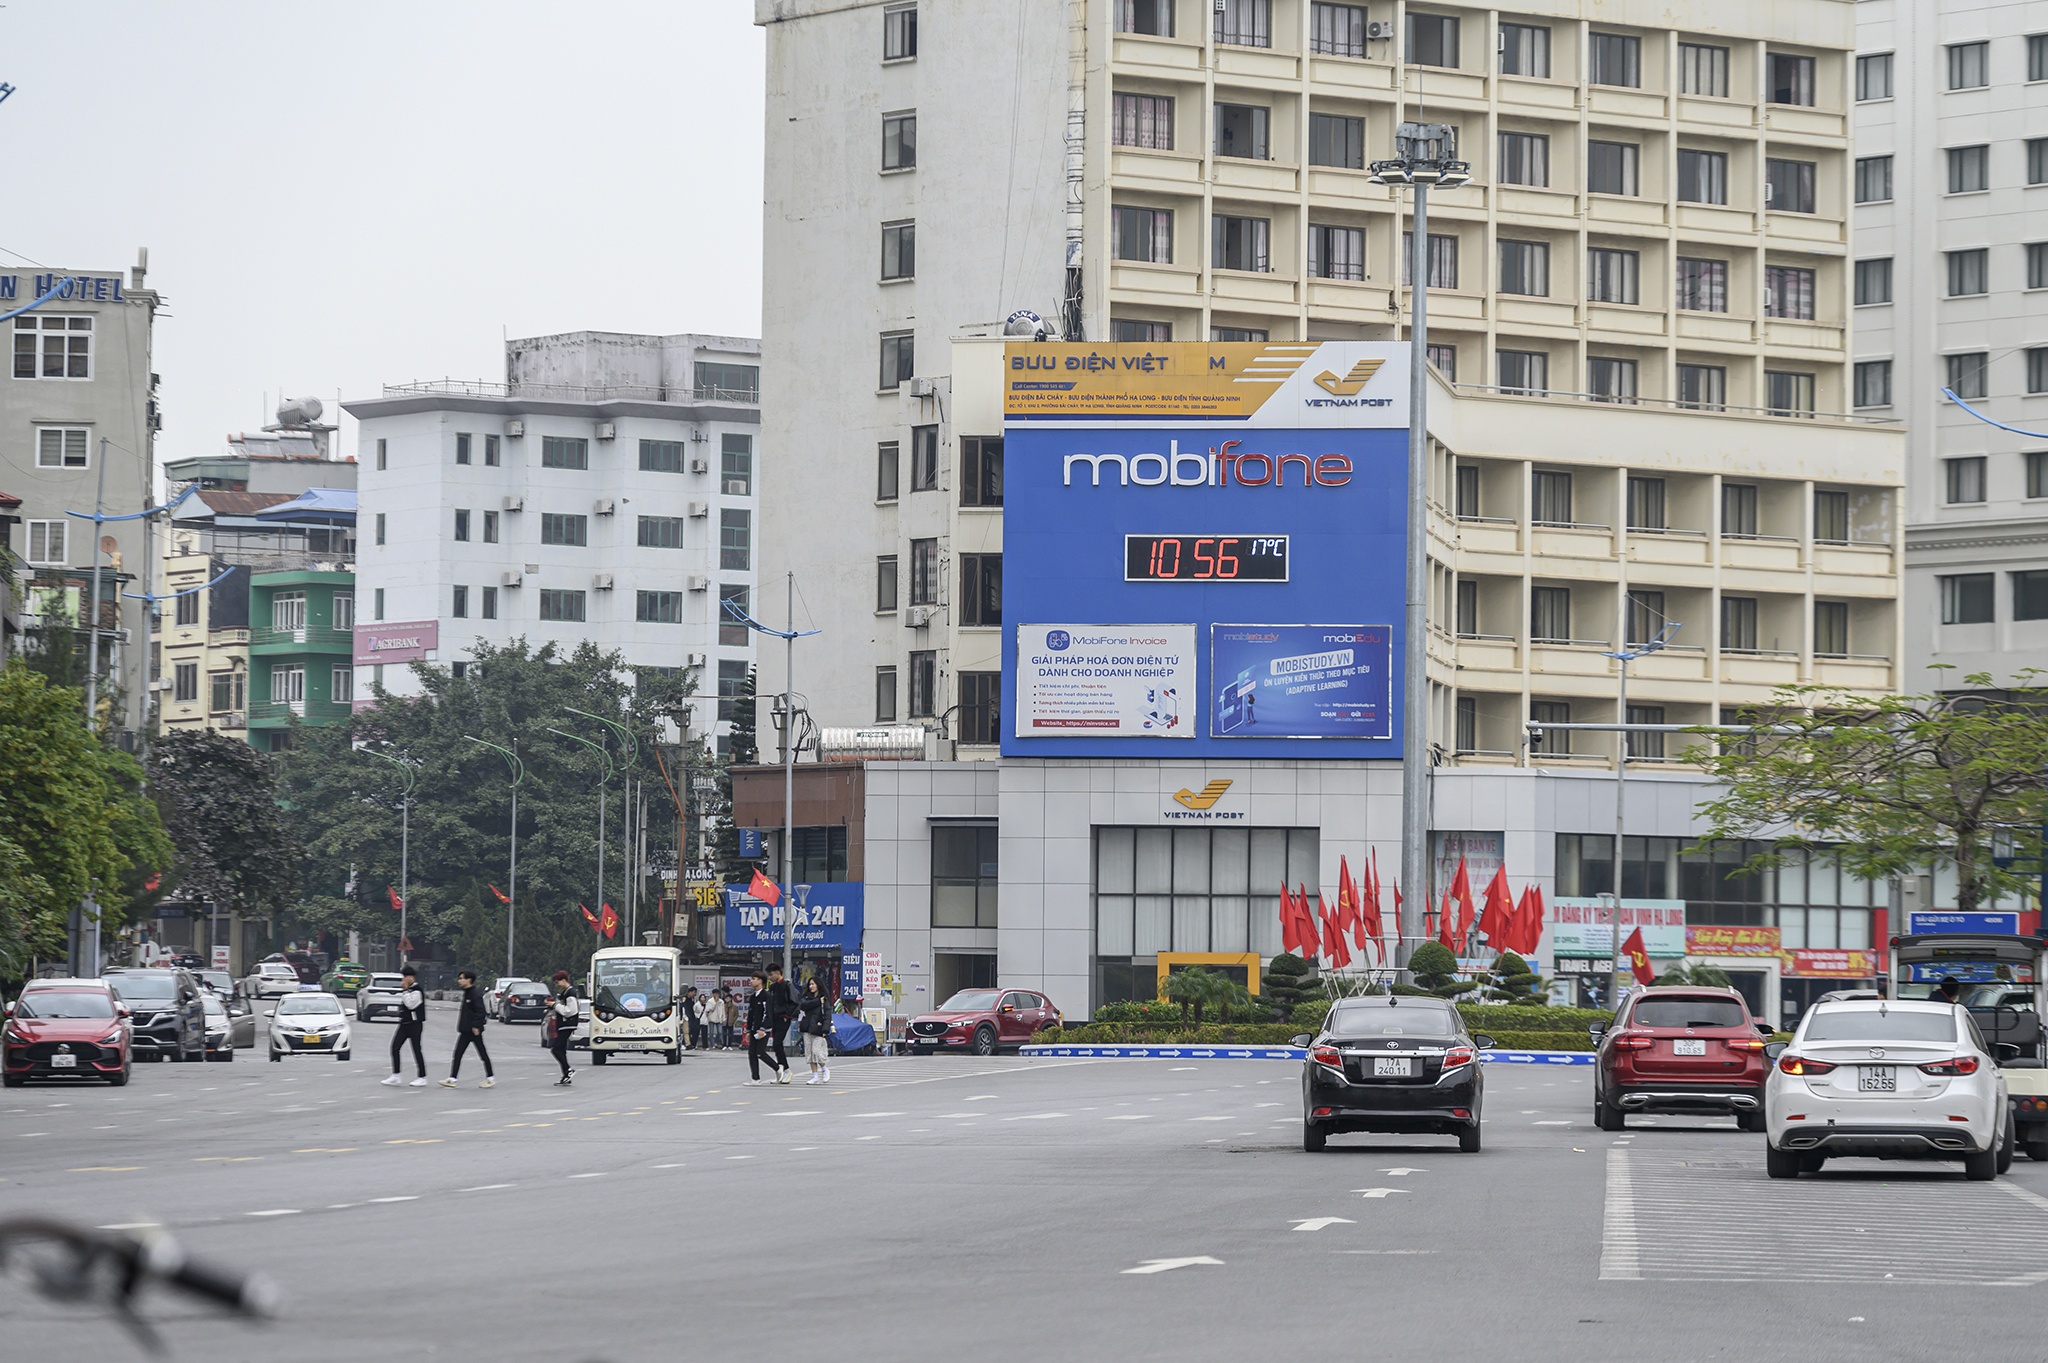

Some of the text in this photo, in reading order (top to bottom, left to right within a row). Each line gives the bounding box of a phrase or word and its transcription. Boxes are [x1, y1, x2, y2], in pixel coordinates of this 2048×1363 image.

[35, 273, 124, 300] HOTEL
[1012, 351, 1225, 373] BƯU ĐIỆN VIỆT M
[1361, 399, 1393, 407] POST
[1063, 439, 1354, 486] mobifone
[1150, 538, 1180, 578] 10
[1194, 538, 1239, 578] 56
[377, 637, 420, 650] AGRIBANK
[1073, 636, 1167, 645] MobiFone Invoice
[1323, 633, 1381, 643] mobiEdu
[1031, 654, 1052, 665] GIẢI
[1056, 654, 1084, 665] PHÁP
[1087, 654, 1108, 665] HOÁ
[1111, 656, 1133, 665] ĐƠN
[1136, 655, 1162, 666] ĐIỆN
[1276, 652, 1350, 674] MOBISTUDY.VN
[1039, 666, 1174, 678] DÀNH CHO DOANH NGHIỆP
[1327, 669, 1341, 679] THEO
[1285, 680, 1348, 696] (ADAPTIVE LEARNING)
[746, 830, 754, 850] ANK
[692, 869, 712, 879] LONG
[739, 906, 769, 931] TẠP
[812, 906, 844, 926] 24H
[1665, 909, 1683, 925] LONG
[843, 953, 860, 965] SIÊU
[1560, 959, 1591, 972] TRAVEL
[722, 978, 740, 987] CHÁO
[845, 971, 858, 982] THỊ
[844, 986, 859, 996] 24H
[1869, 1067, 1887, 1078] 14A
[1862, 1079, 1894, 1089] 152.55
